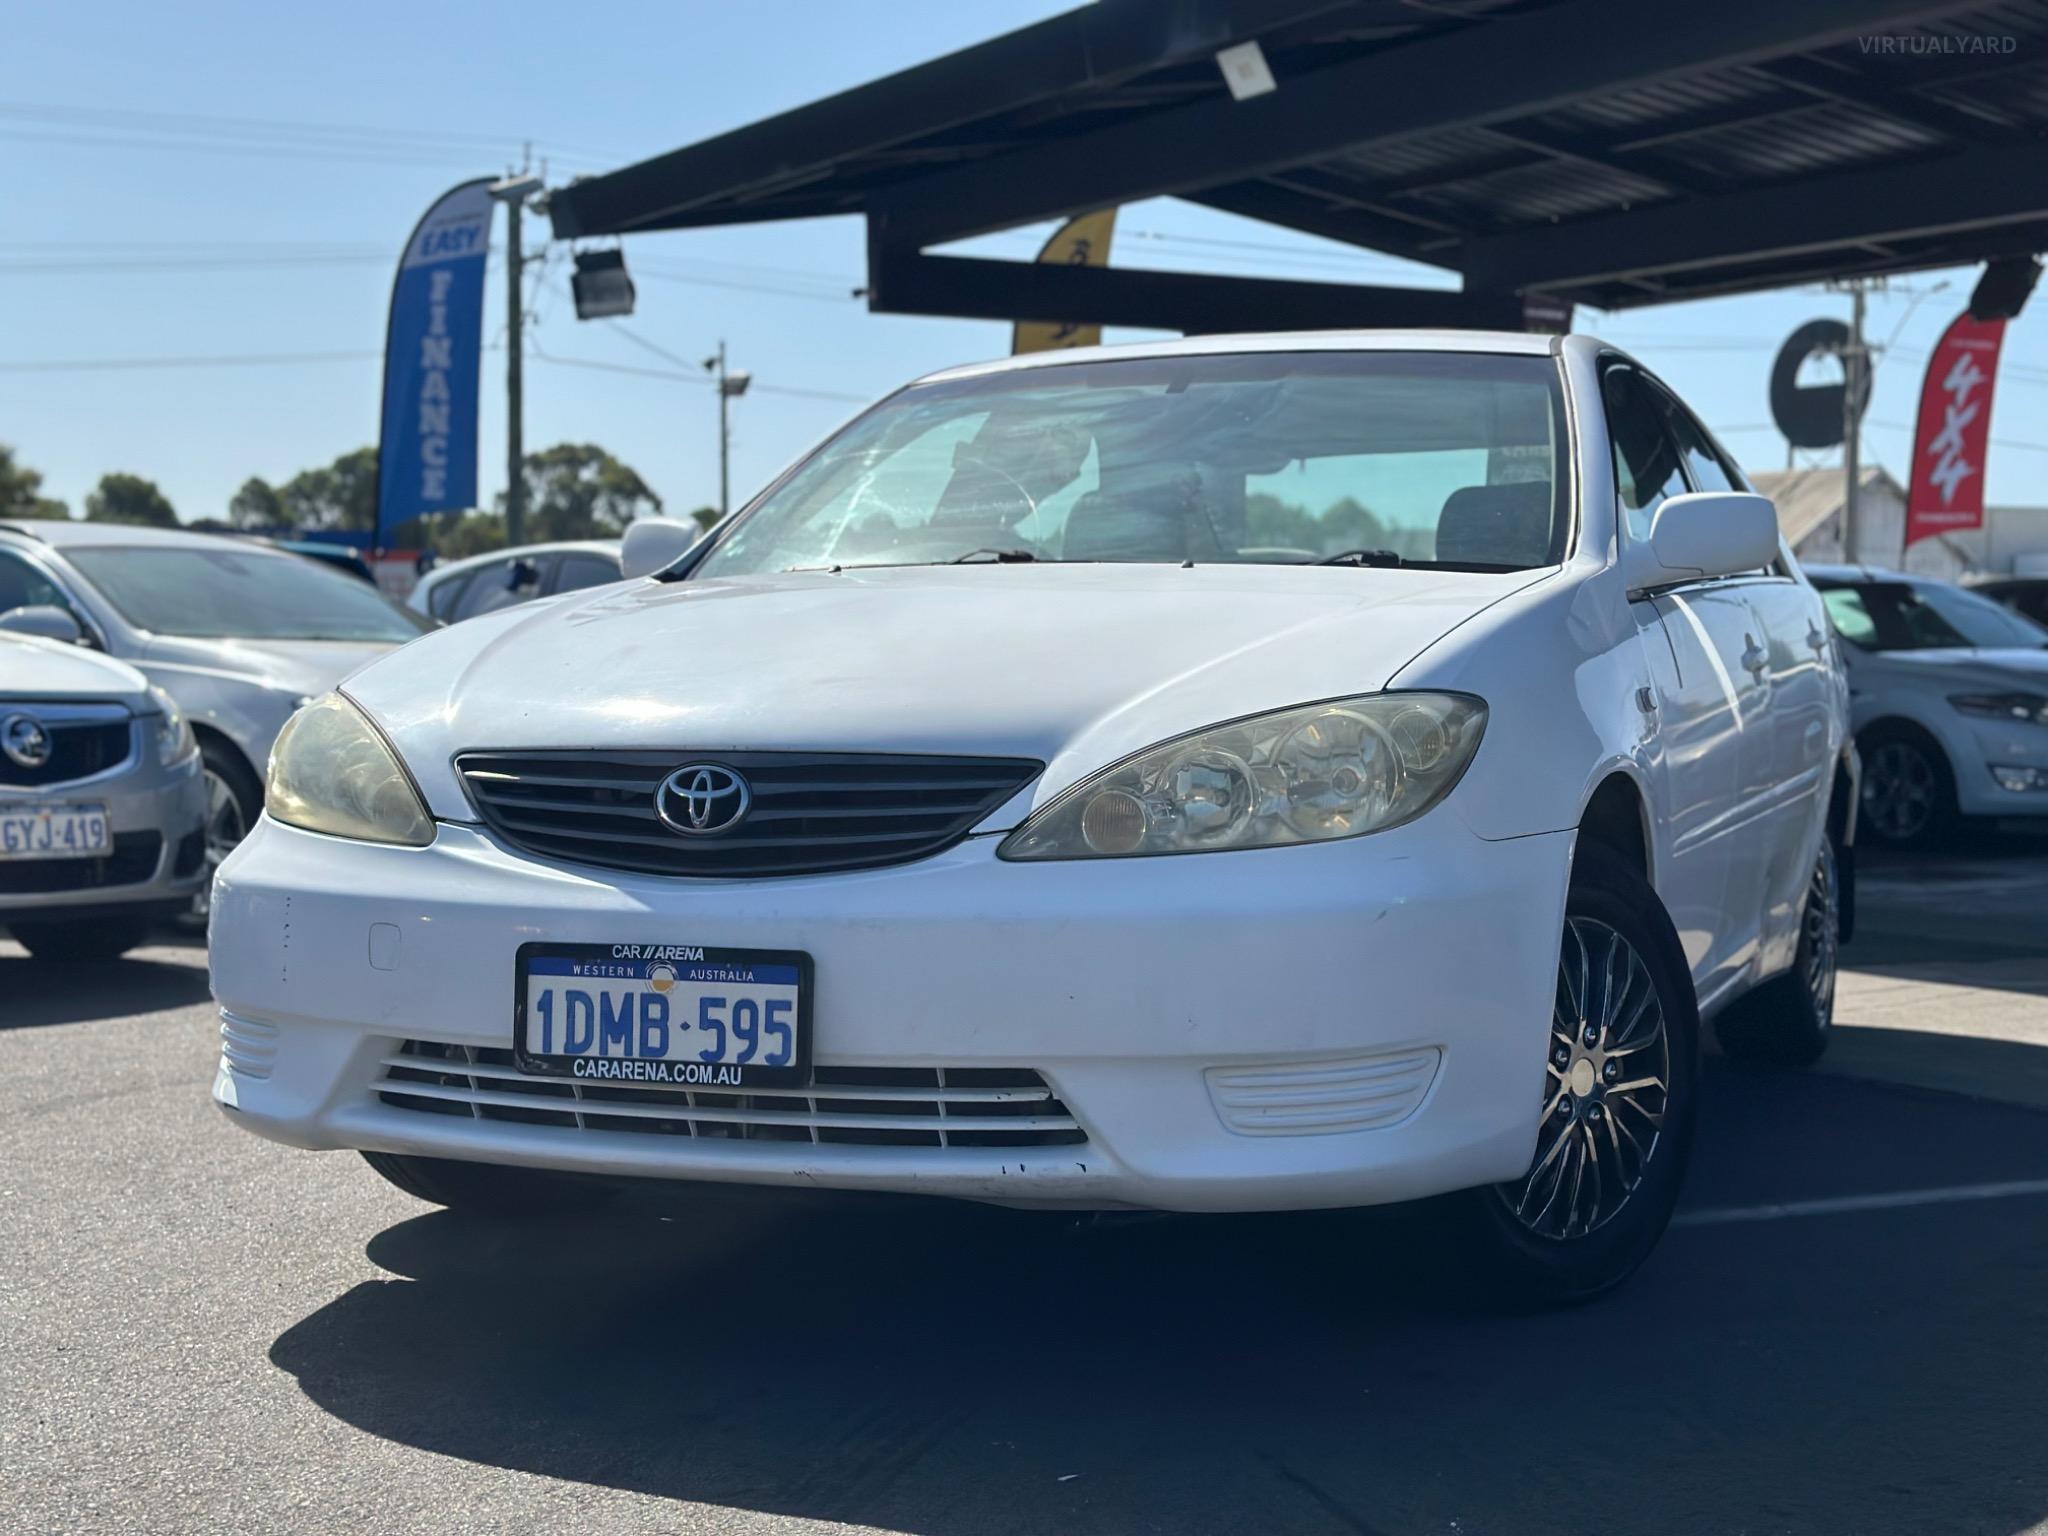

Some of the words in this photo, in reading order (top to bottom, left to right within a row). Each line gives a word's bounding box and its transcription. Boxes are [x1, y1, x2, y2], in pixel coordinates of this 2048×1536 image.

[420, 225, 481, 257] EASY
[419, 271, 453, 500] FINANCE
[612, 945, 641, 959] CAR
[573, 964, 635, 977] WESTERN
[689, 969, 755, 982] AUSTRALIA
[573, 1058, 742, 1086] CARARENA.COM.AU
